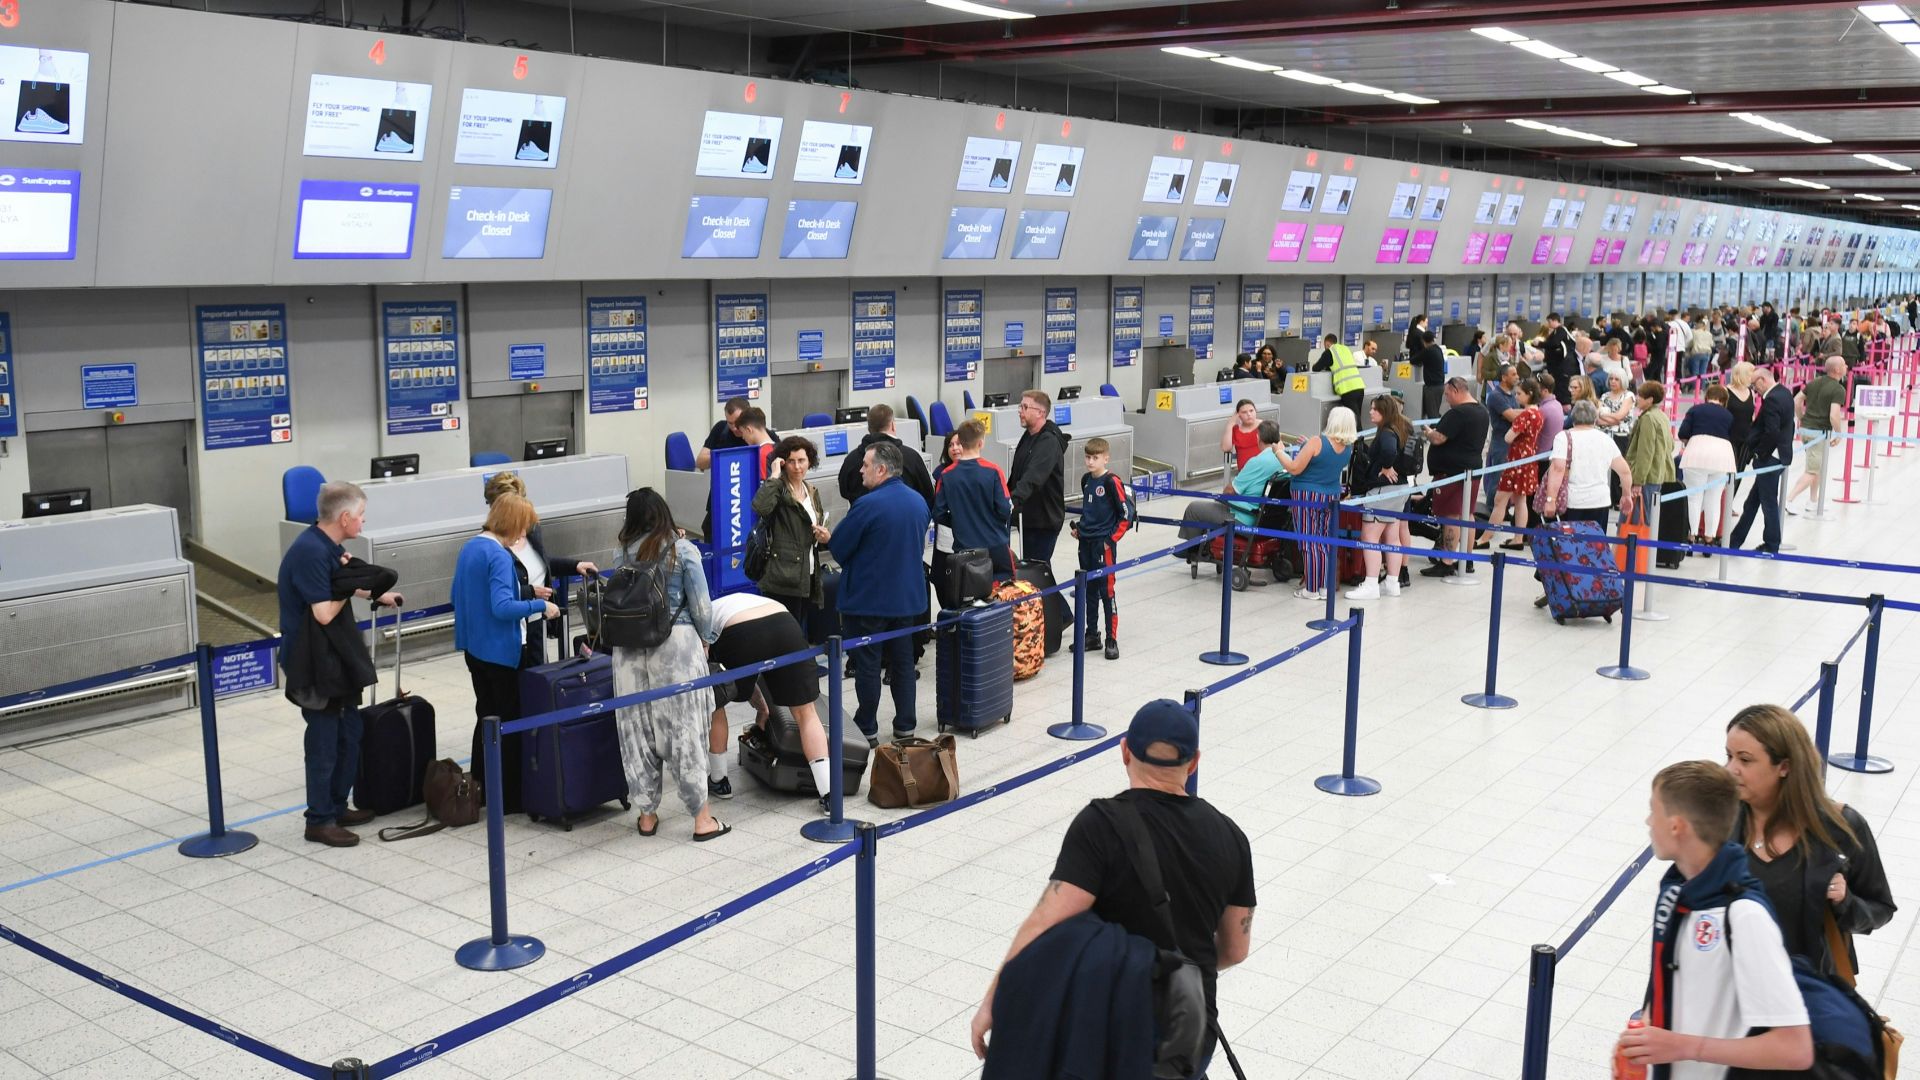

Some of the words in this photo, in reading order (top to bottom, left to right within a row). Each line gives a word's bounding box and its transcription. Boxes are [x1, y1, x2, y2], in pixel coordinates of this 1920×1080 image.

[0, 0, 20, 28] 3
[368, 39, 386, 65] 4
[513, 55, 529, 80] 5
[744, 82, 757, 103] 6
[342, 104, 371, 112] SHOPPING
[839, 92, 851, 113] 7
[22, 177, 71, 187] SunExpress
[377, 188, 414, 197] SunExpress
[466, 209, 506, 222] Check-in
[508, 211, 530, 222] Desk
[702, 216, 733, 227] Check-in
[734, 217, 750, 227] Desk
[798, 219, 825, 228] Check-in
[826, 220, 841, 229] Desk
[482, 225, 512, 236] Closed
[713, 229, 736, 239] Closed
[807, 231, 828, 240] Closed
[418, 305, 452, 313] Information
[591, 301, 615, 309] Important
[202, 310, 237, 318] Important
[238, 308, 279, 316] Information
[1356, 541, 1380, 550] Departure
[224, 652, 255, 663] NOTICE
[220, 664, 240, 672] Please
[241, 660, 258, 668] allow
[214, 670, 240, 679] baggage
[219, 678, 238, 686] before
[239, 673, 261, 683] placing
[400, 1057, 418, 1069] LONDON
[418, 1050, 433, 1060] LUTON
